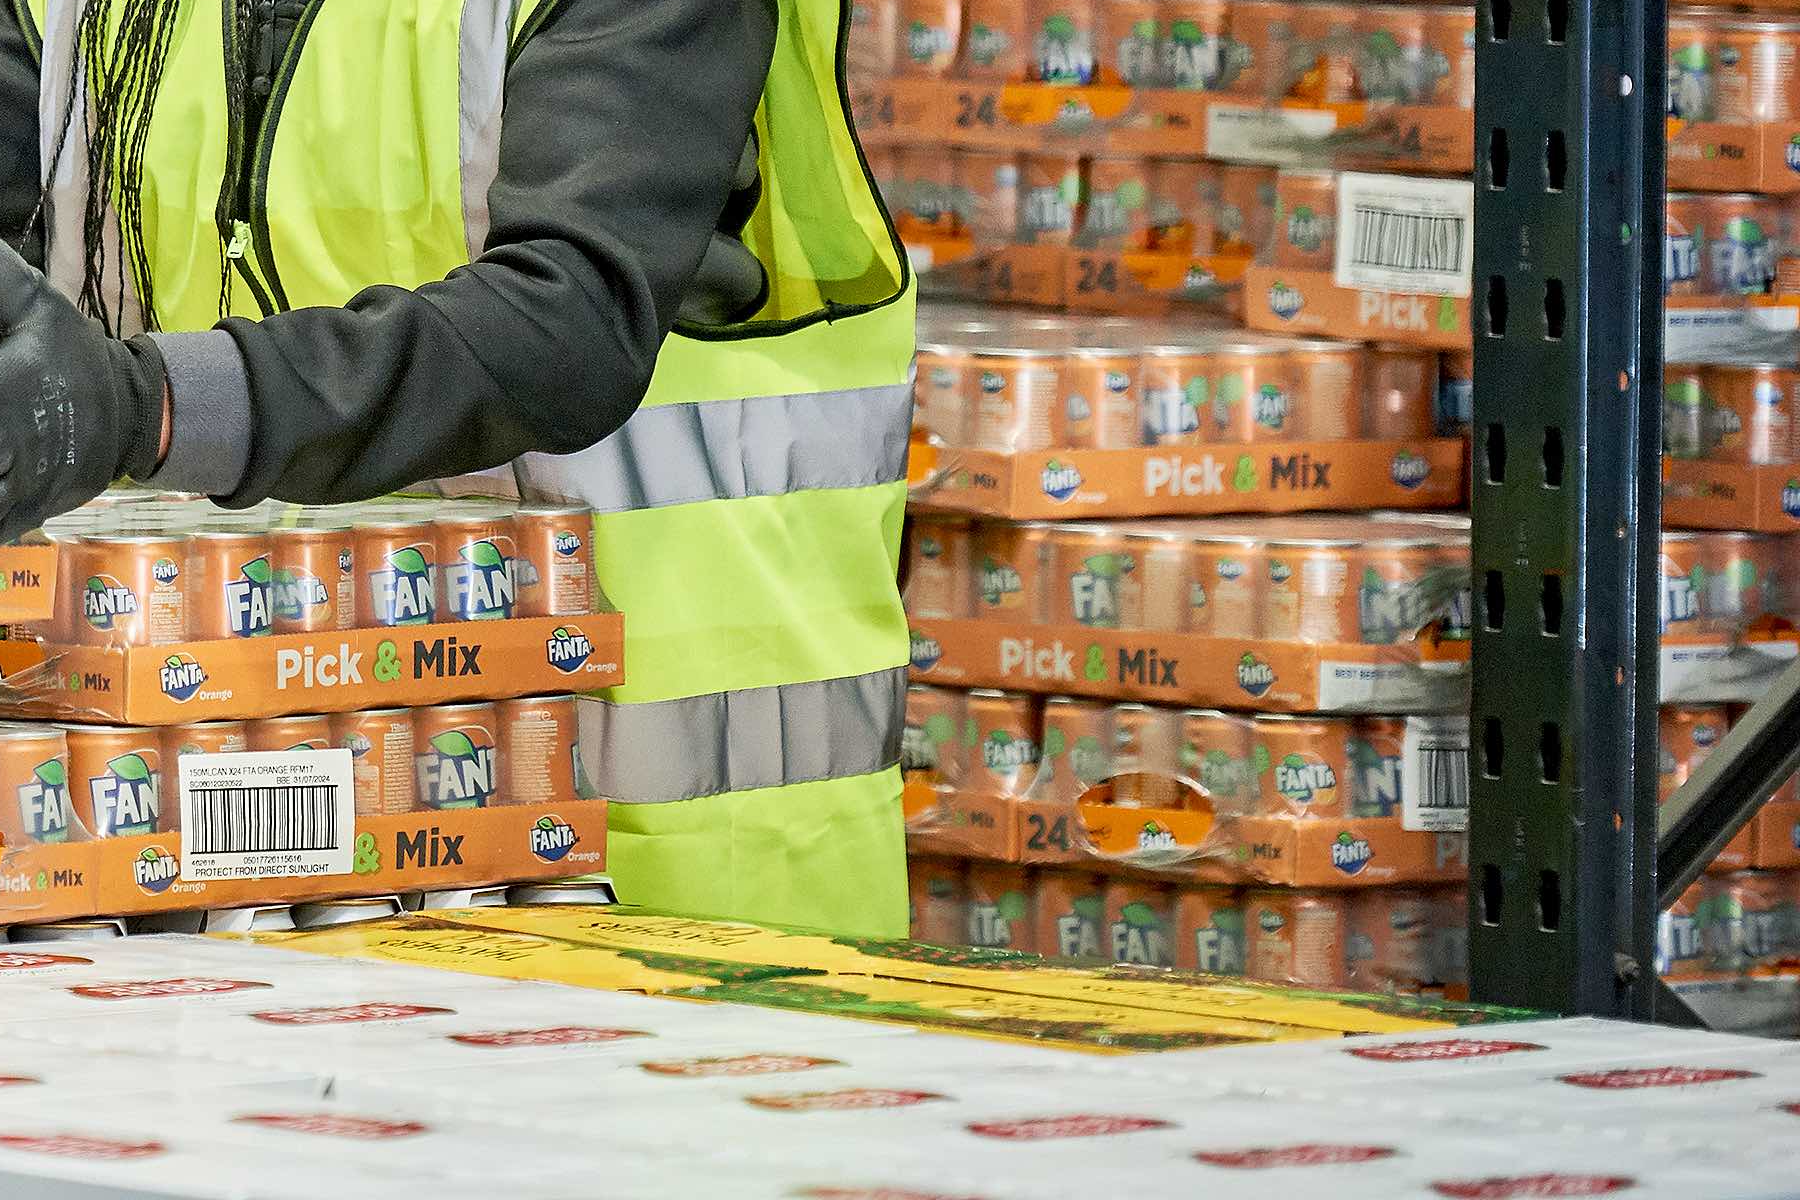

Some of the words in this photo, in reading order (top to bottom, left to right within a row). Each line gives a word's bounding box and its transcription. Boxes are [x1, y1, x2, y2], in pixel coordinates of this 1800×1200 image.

[1359, 288, 1428, 333] Pick
[1144, 454, 1226, 498] Pick
[1269, 452, 1331, 492] Mix
[11, 570, 41, 589] Mix
[151, 562, 180, 580] FANTA
[83, 586, 139, 617] FANTA
[369, 564, 436, 618] FAN
[547, 634, 592, 662] FANTA
[159, 662, 206, 692] FANTA
[276, 643, 363, 691] Pick
[374, 639, 402, 683] &
[413, 636, 482, 680] Mix
[585, 661, 617, 674] Orange
[1000, 638, 1077, 683] Pick
[1117, 647, 1180, 688] Mix
[84, 672, 111, 693] Mix
[199, 689, 233, 702] Orange
[257, 765, 289, 776] ORANGE
[530, 823, 578, 853] FANTA
[1027, 813, 1070, 852] 24
[353, 830, 380, 874] &
[396, 826, 465, 871] Mix
[568, 850, 601, 863] Orange
[53, 868, 84, 888] Mix
[195, 867, 234, 878] PROTECT
[235, 866, 257, 876] FROM
[258, 864, 287, 875] DIRECT
[288, 863, 330, 874] SUNLIGHT
[171, 881, 207, 893] Orange
